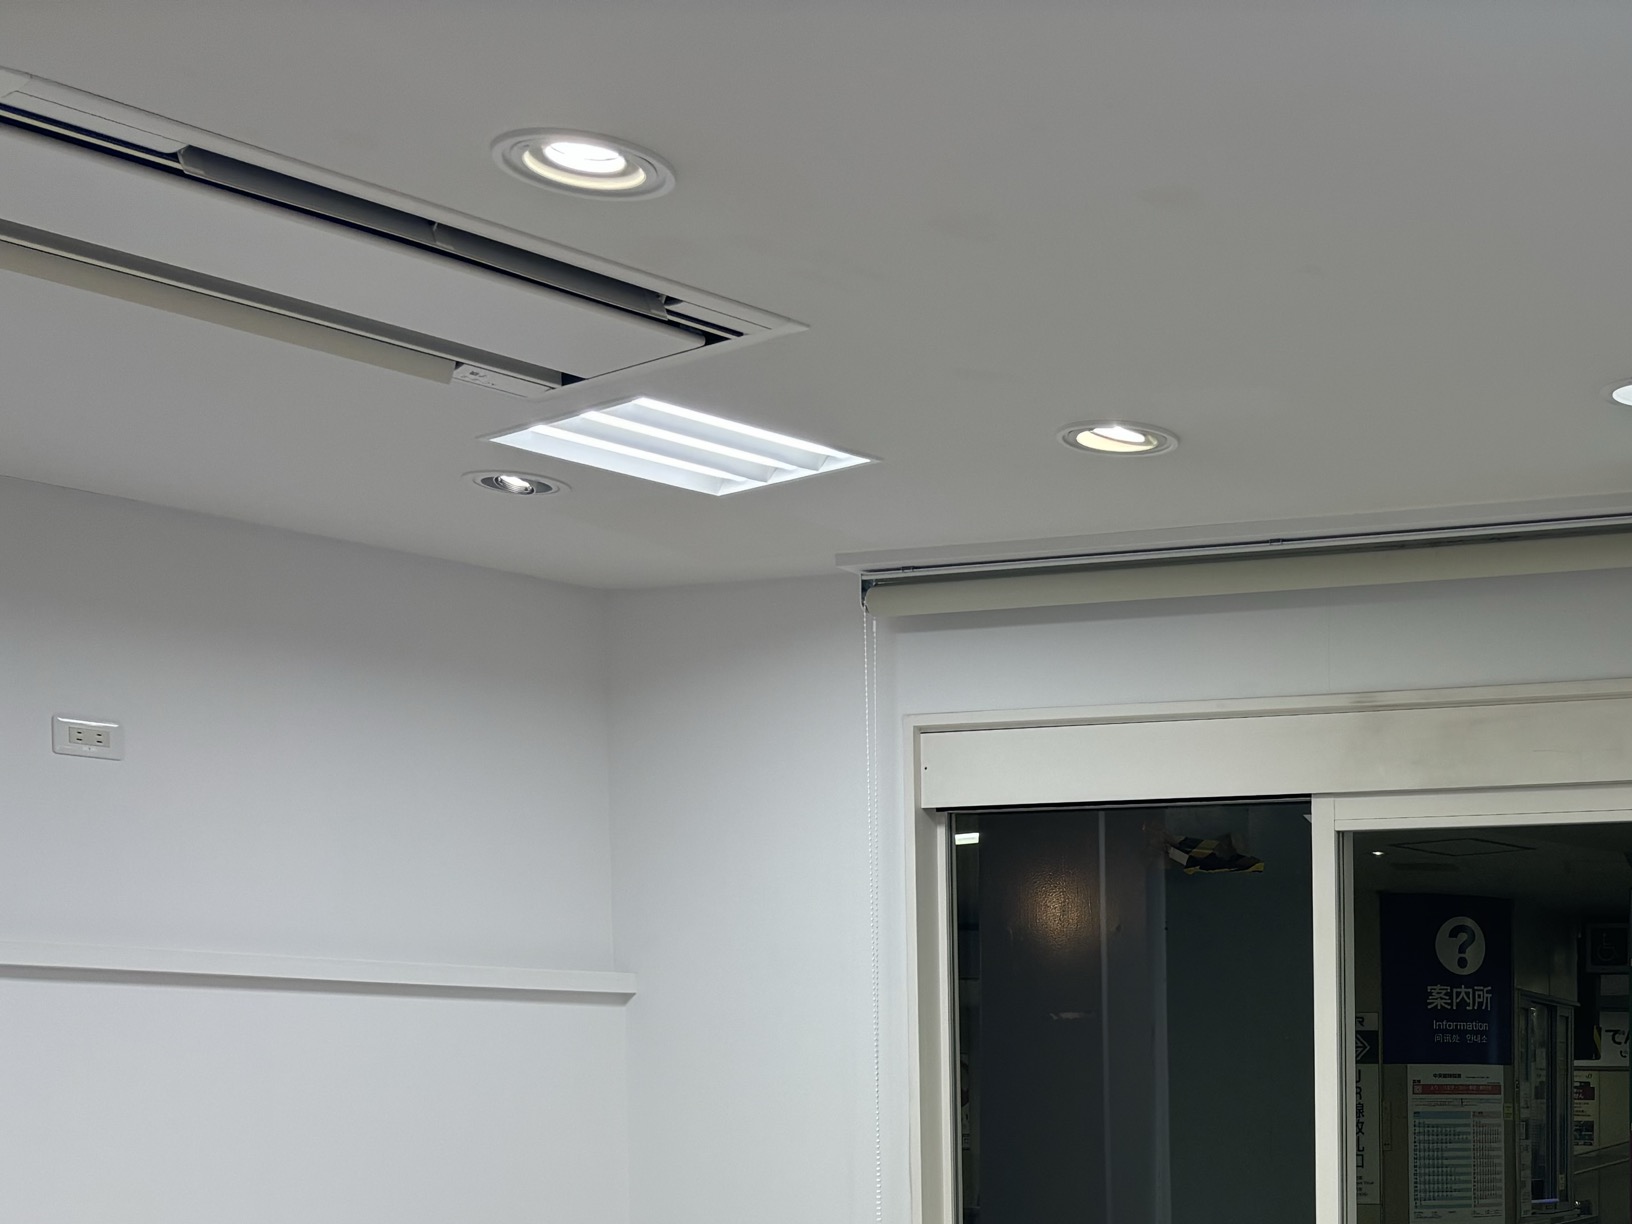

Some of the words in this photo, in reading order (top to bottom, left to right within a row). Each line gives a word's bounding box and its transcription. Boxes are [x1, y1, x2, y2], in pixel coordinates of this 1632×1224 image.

[1426, 984, 1493, 1011] 案内所
[1433, 1019, 1489, 1031] Information
